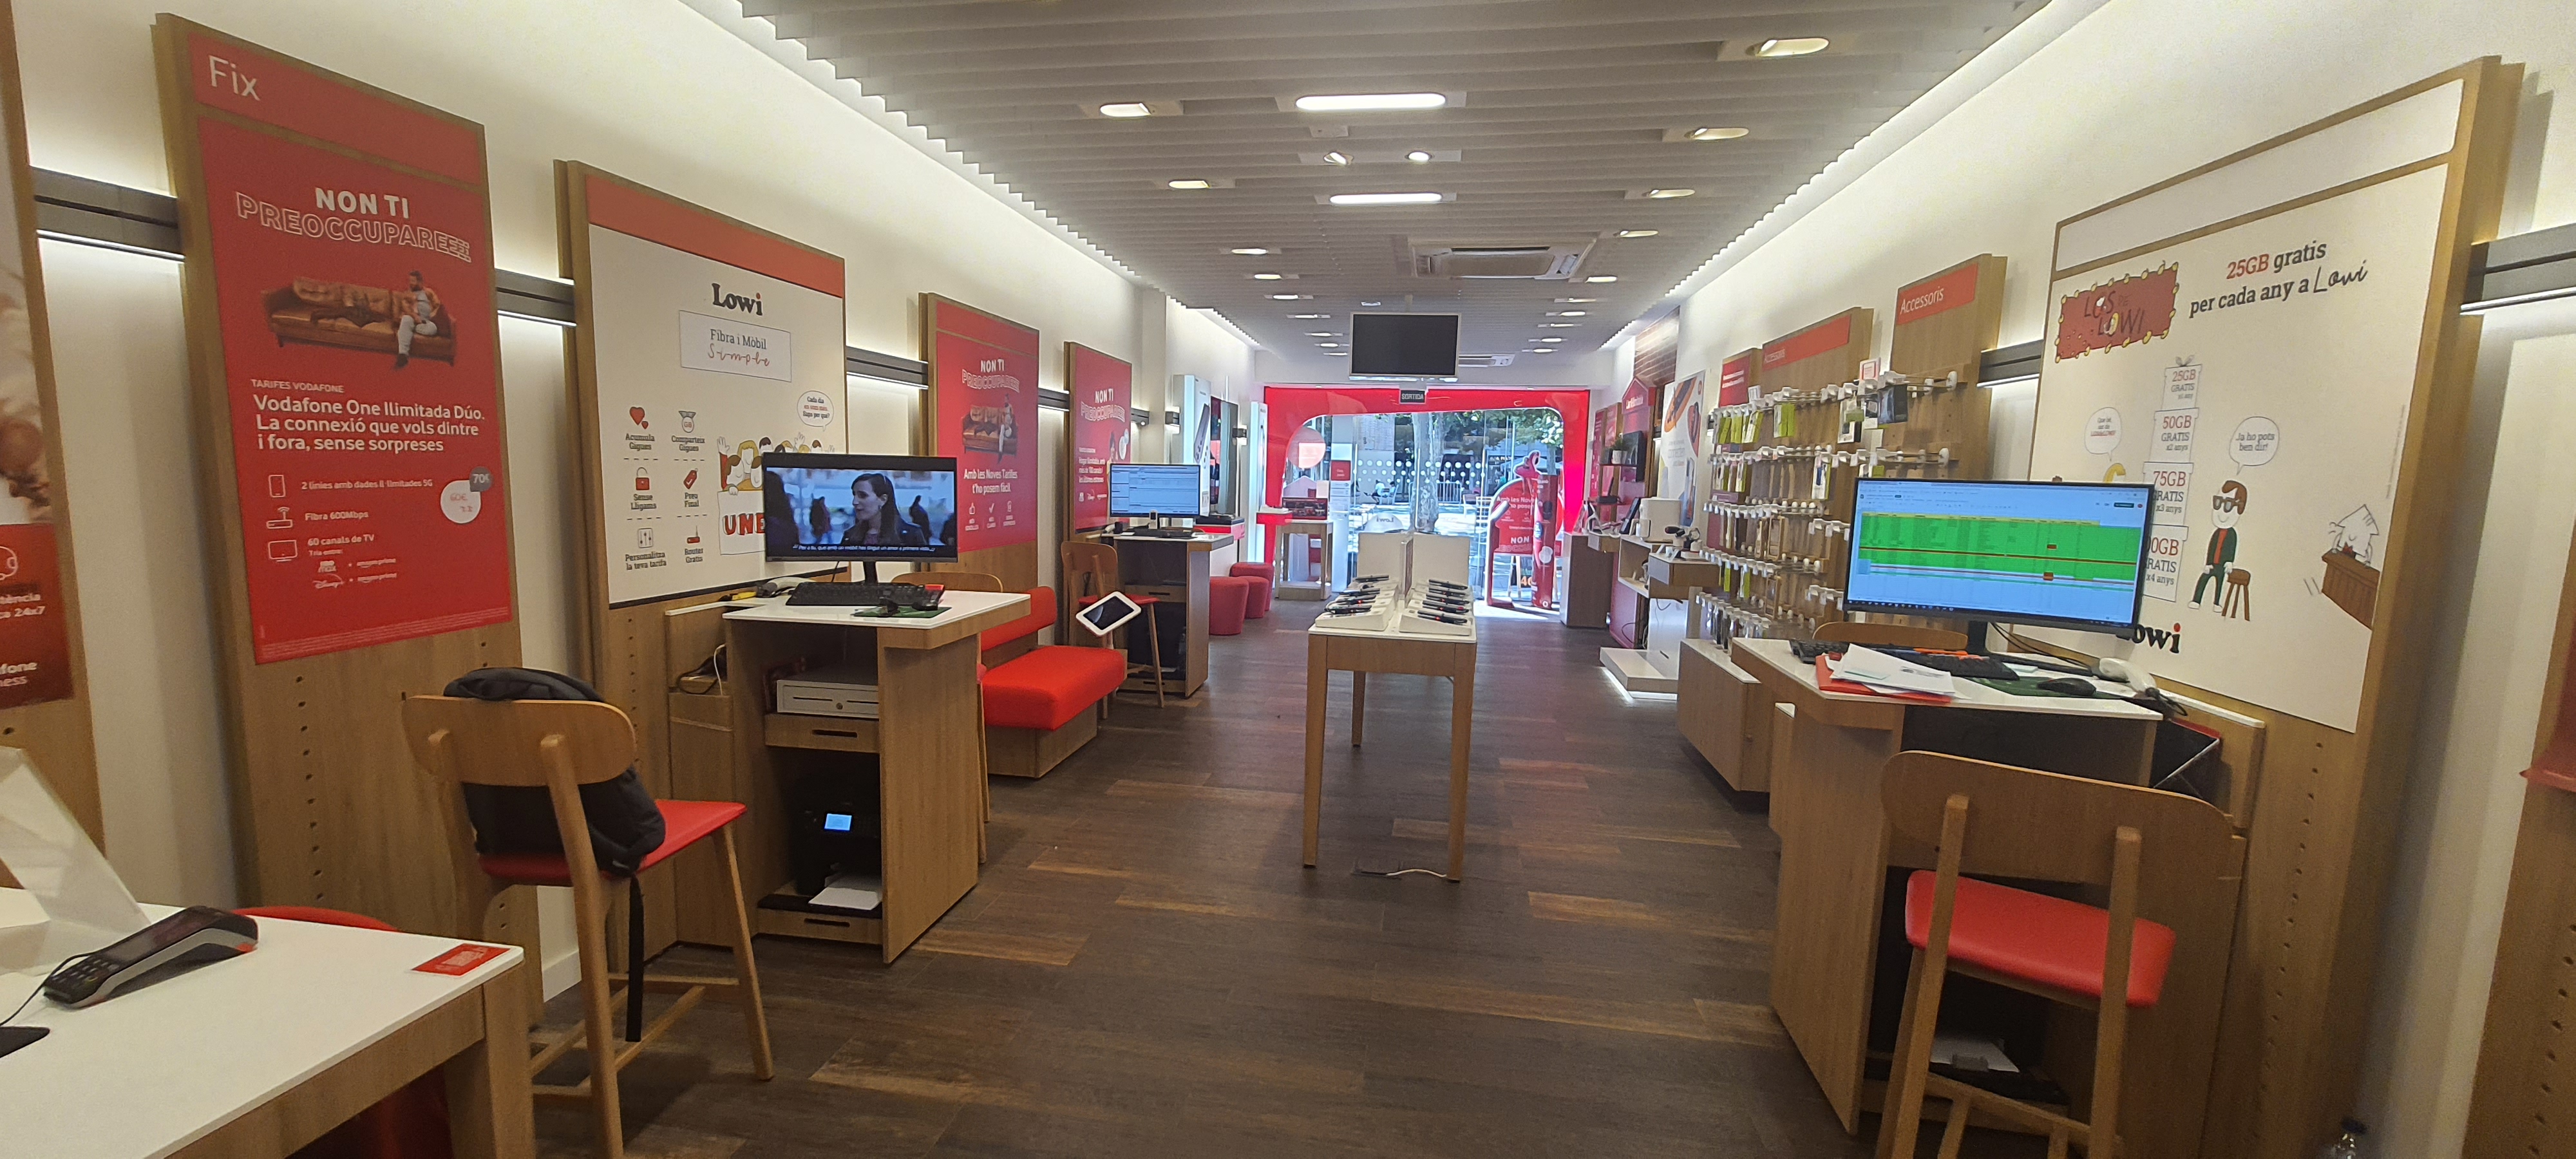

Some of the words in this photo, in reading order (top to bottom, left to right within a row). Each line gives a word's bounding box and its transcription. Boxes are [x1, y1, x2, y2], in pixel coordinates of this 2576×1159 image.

[208, 55, 260, 101] Fix
[316, 187, 378, 215] NON
[384, 194, 409, 218] TI
[2226, 253, 2270, 280] 25GB
[2273, 240, 2327, 274] gratis
[2189, 296, 2215, 319] per
[2219, 287, 2256, 308] cada
[2260, 281, 2295, 302] any
[2298, 278, 2309, 294] a
[2313, 259, 2369, 294] Lowi
[711, 283, 763, 316] Lowi
[1900, 286, 1944, 316] Accessoris
[2084, 290, 2116, 319] LOS
[2098, 308, 2145, 335] LOWI
[710, 328, 735, 344] Fibra
[737, 334, 740, 345] i
[743, 335, 767, 350] Mòbil
[708, 343, 770, 367] Simple
[980, 359, 997, 373] NON
[998, 359, 1005, 372] TI
[2172, 369, 2197, 382] 25GB
[251, 379, 290, 390] TARIFES
[292, 382, 345, 393] VODAFONE
[2171, 383, 2195, 393] GRATIS
[1095, 389, 1108, 404] NON
[1108, 388, 1114, 401] TI
[254, 394, 343, 415] Vodafone
[346, 400, 381, 416] One
[384, 402, 451, 419] Ilimitada
[453, 405, 485, 420] Dúo.
[256, 414, 279, 431] La
[285, 417, 366, 433] connexió
[370, 422, 399, 437] que
[402, 420, 435, 435] vols
[437, 420, 479, 436] dintre
[2163, 415, 2192, 429] 50GB
[258, 434, 263, 449] i
[268, 434, 310, 451] fora,
[314, 438, 365, 450] sense
[369, 439, 444, 454] sorpreses
[625, 433, 655, 442] Acumula
[671, 435, 705, 444] Comparteix
[2161, 432, 2190, 442] GRATIS
[2235, 432, 2245, 441] Ja
[2246, 432, 2257, 441] ho
[2258, 433, 2275, 443] pots
[964, 469, 977, 480] Amb
[986, 469, 1002, 479] Noves
[1002, 469, 1018, 479] Tarifes
[2153, 471, 2186, 487] 75GB
[983, 485, 1000, 496] posem
[305, 512, 328, 521] Fibra
[330, 511, 369, 521] 600Mbps
[2165, 505, 2182, 514] anys
[308, 537, 319, 547] 60
[321, 535, 350, 546] canals
[351, 534, 362, 544] de
[363, 534, 374, 542] TV
[1511, 536, 1530, 544] NON
[625, 552, 666, 562] Personalitza
[2146, 558, 2177, 573] RATIS
[2146, 573, 2155, 582] x4
[2157, 576, 2175, 586] anys
[2116, 622, 2181, 654] owi
